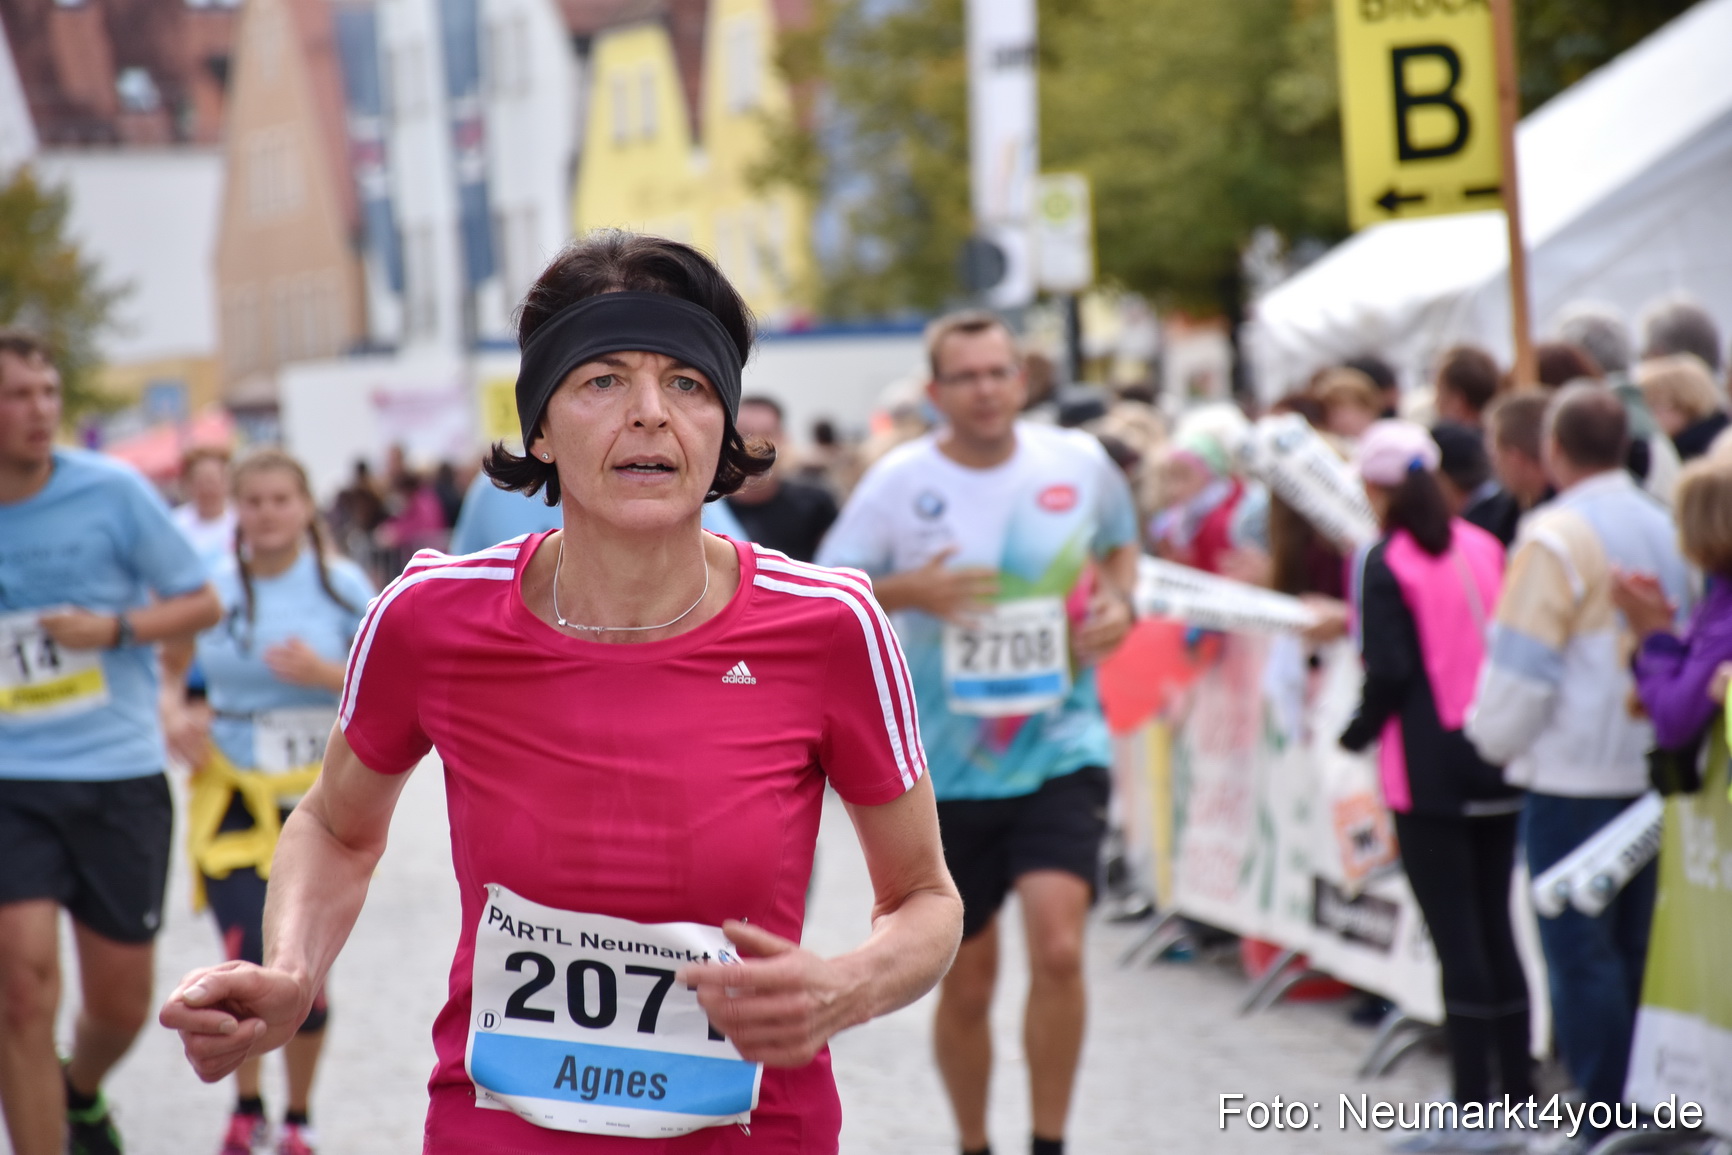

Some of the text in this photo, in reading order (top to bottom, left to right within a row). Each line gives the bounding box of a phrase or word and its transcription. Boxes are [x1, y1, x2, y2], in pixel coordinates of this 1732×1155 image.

[1390, 44, 1471, 162] B
[959, 629, 1058, 672] 2708
[721, 675, 757, 685] adidas
[488, 905, 711, 965] PARTL Neumarkt
[553, 1055, 668, 1101] Agnes
